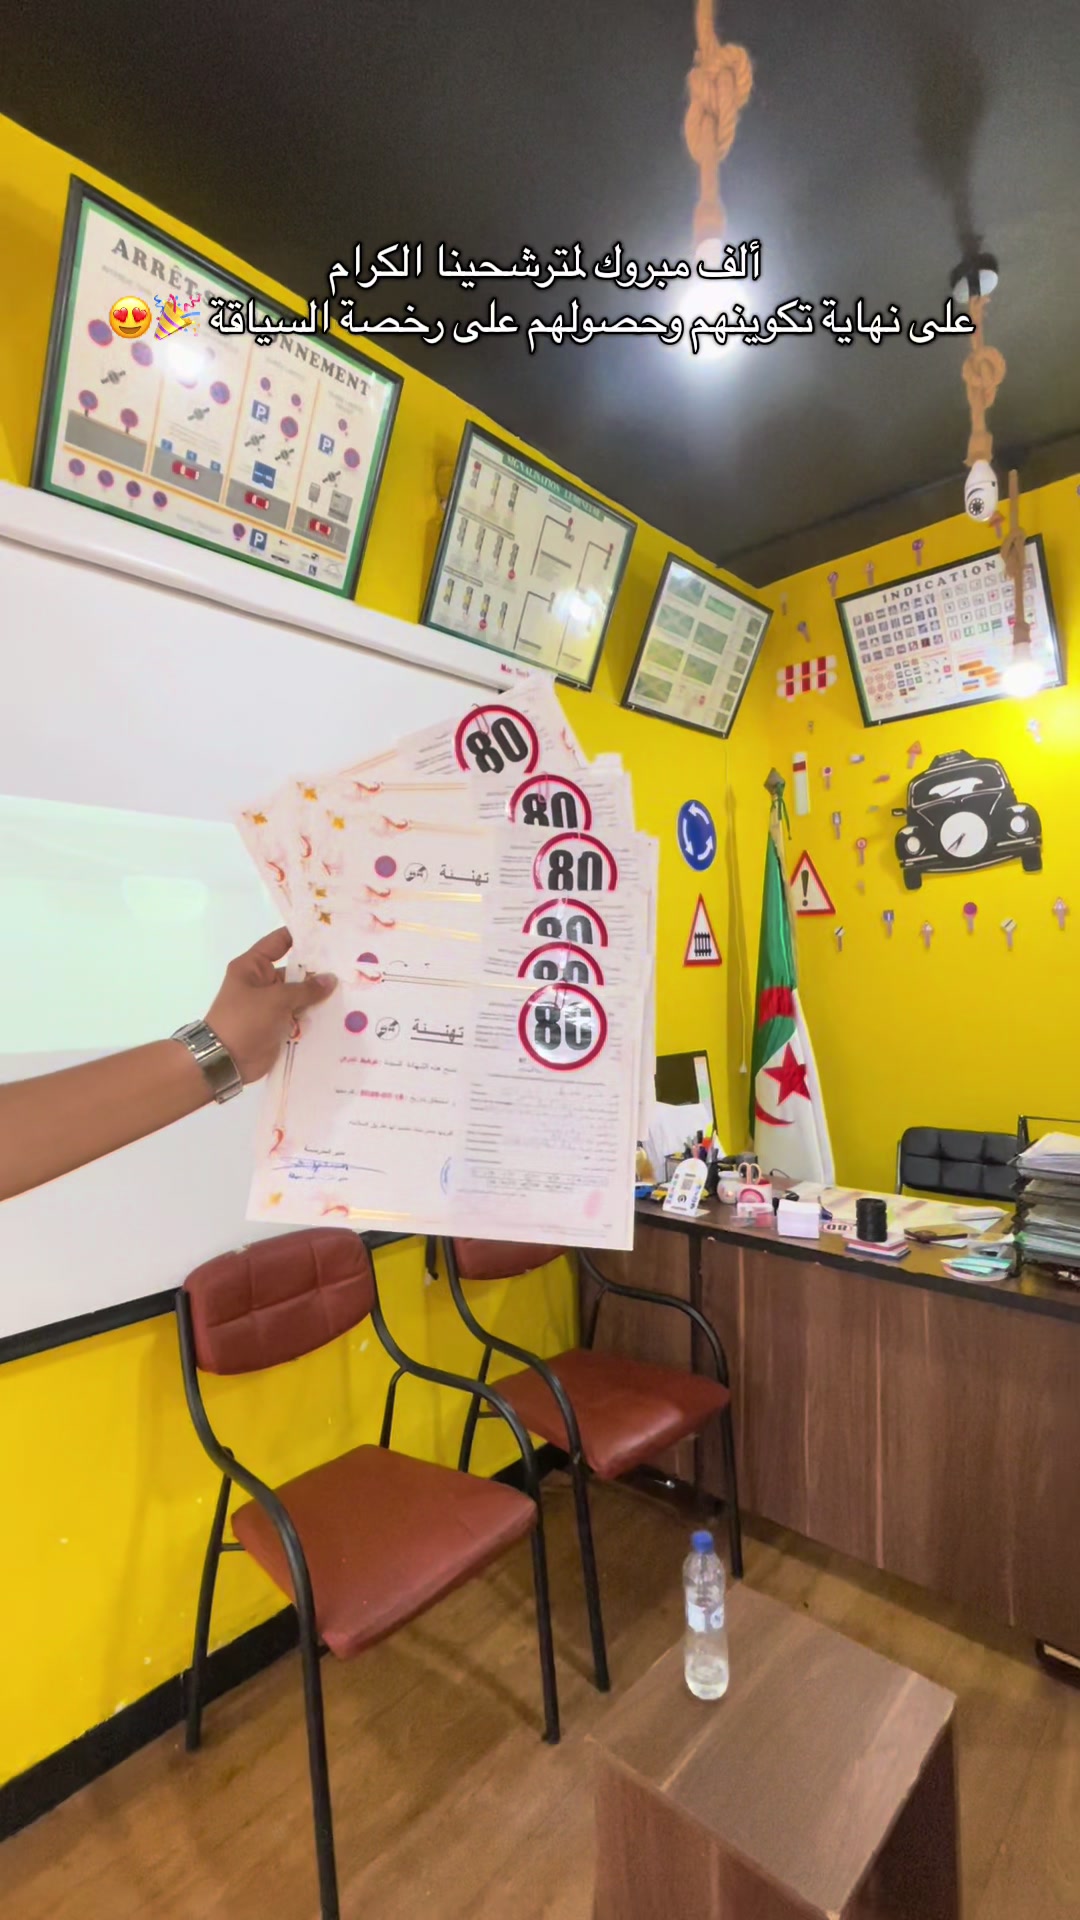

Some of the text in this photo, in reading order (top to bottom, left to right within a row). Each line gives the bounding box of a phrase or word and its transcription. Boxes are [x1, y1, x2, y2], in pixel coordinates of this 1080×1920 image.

[882, 560, 997, 603] INDICATION
[466, 717, 528, 773] 80
[548, 850, 603, 891] 80
[534, 1001, 592, 1051] 80
